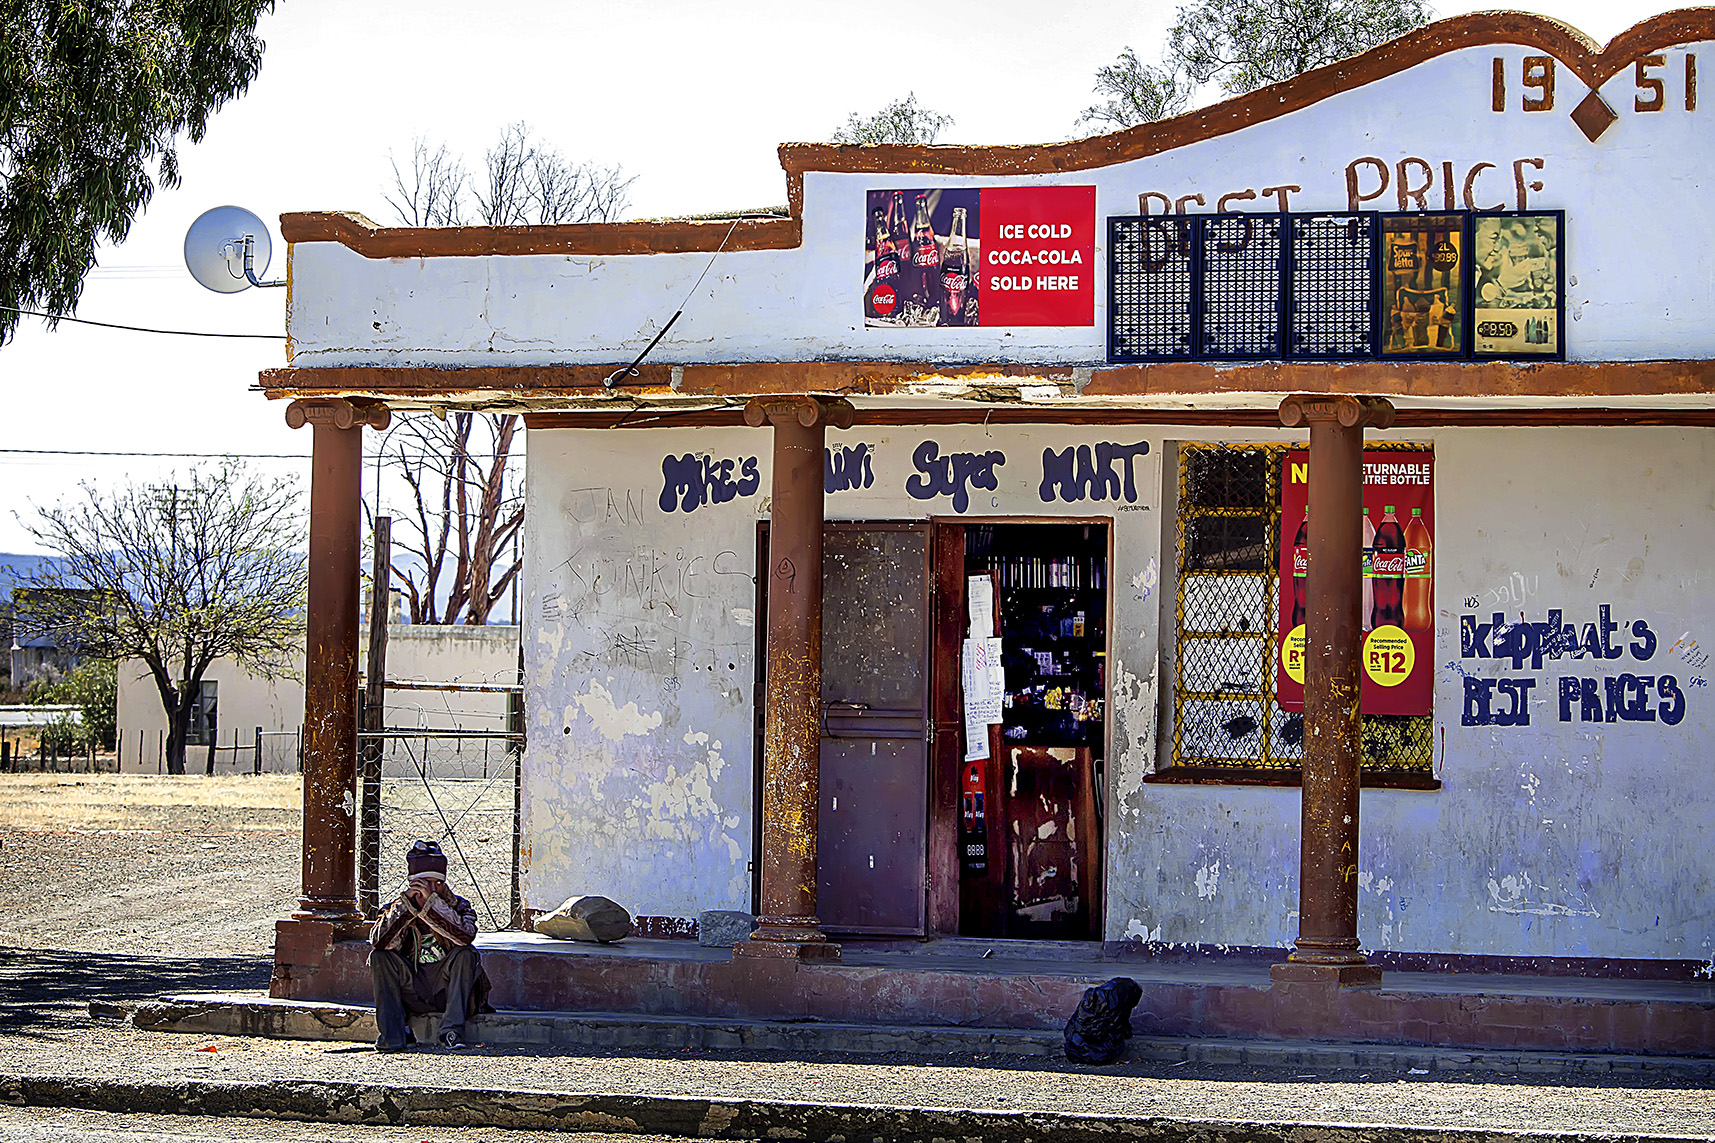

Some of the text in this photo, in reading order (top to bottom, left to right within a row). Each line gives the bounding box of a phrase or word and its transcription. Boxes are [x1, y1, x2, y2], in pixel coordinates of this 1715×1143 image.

[999, 224, 1072, 239] ICE COLD
[988, 250, 1083, 265] COCA-COLA
[990, 275, 1079, 291] SOLD HERE
[1363, 475, 1430, 485] ITRE BOTTLE
[1370, 651, 1406, 673] R12
[1460, 673, 1687, 727] BEST PRICES
